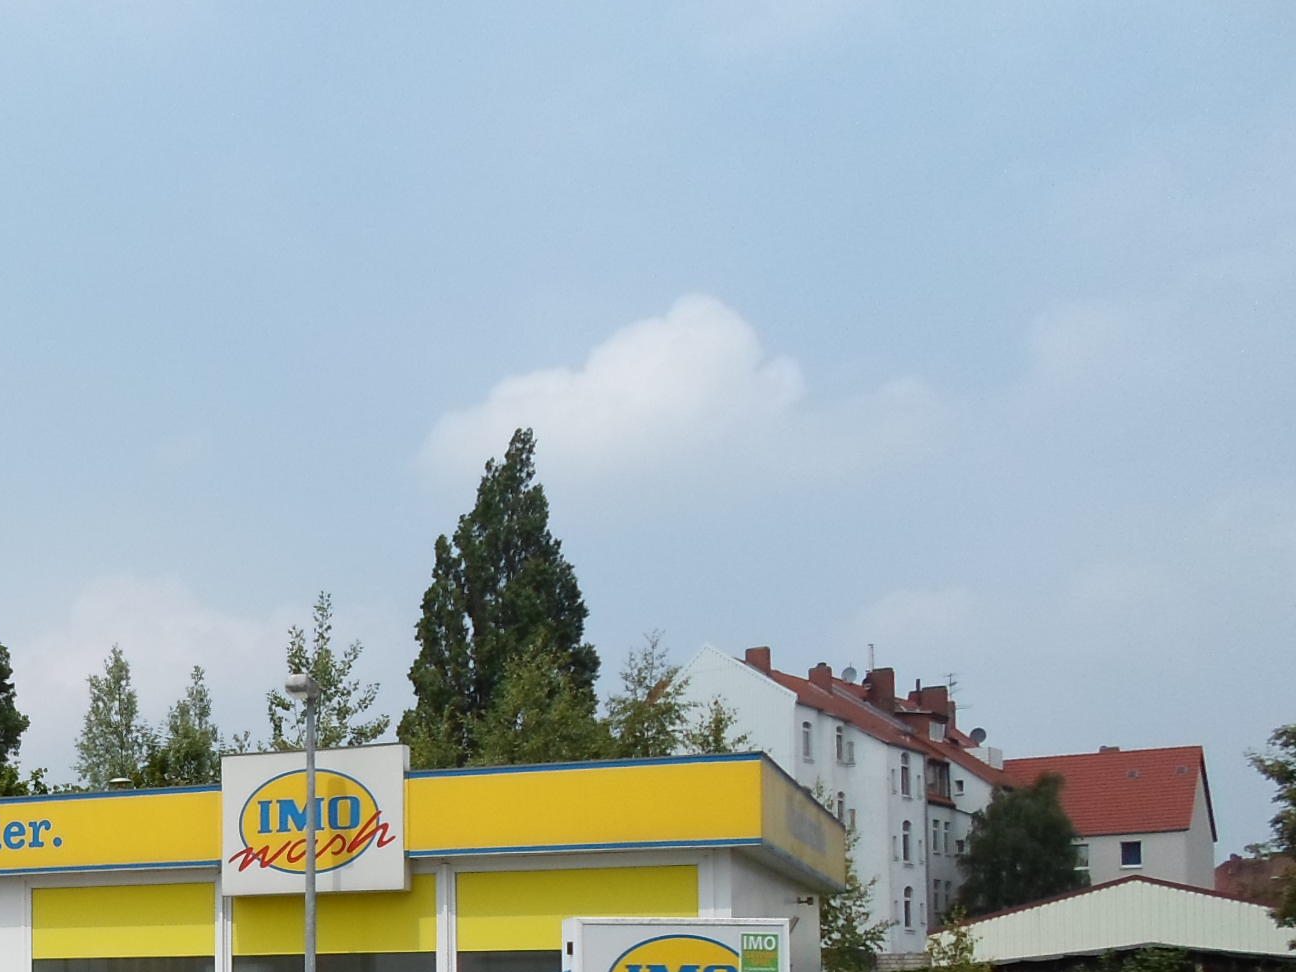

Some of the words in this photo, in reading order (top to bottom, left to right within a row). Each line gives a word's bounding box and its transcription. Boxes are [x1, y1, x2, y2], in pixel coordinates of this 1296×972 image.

[257, 795, 361, 834] IMO
[228, 810, 396, 872] wash
[743, 935, 777, 951] IMO
